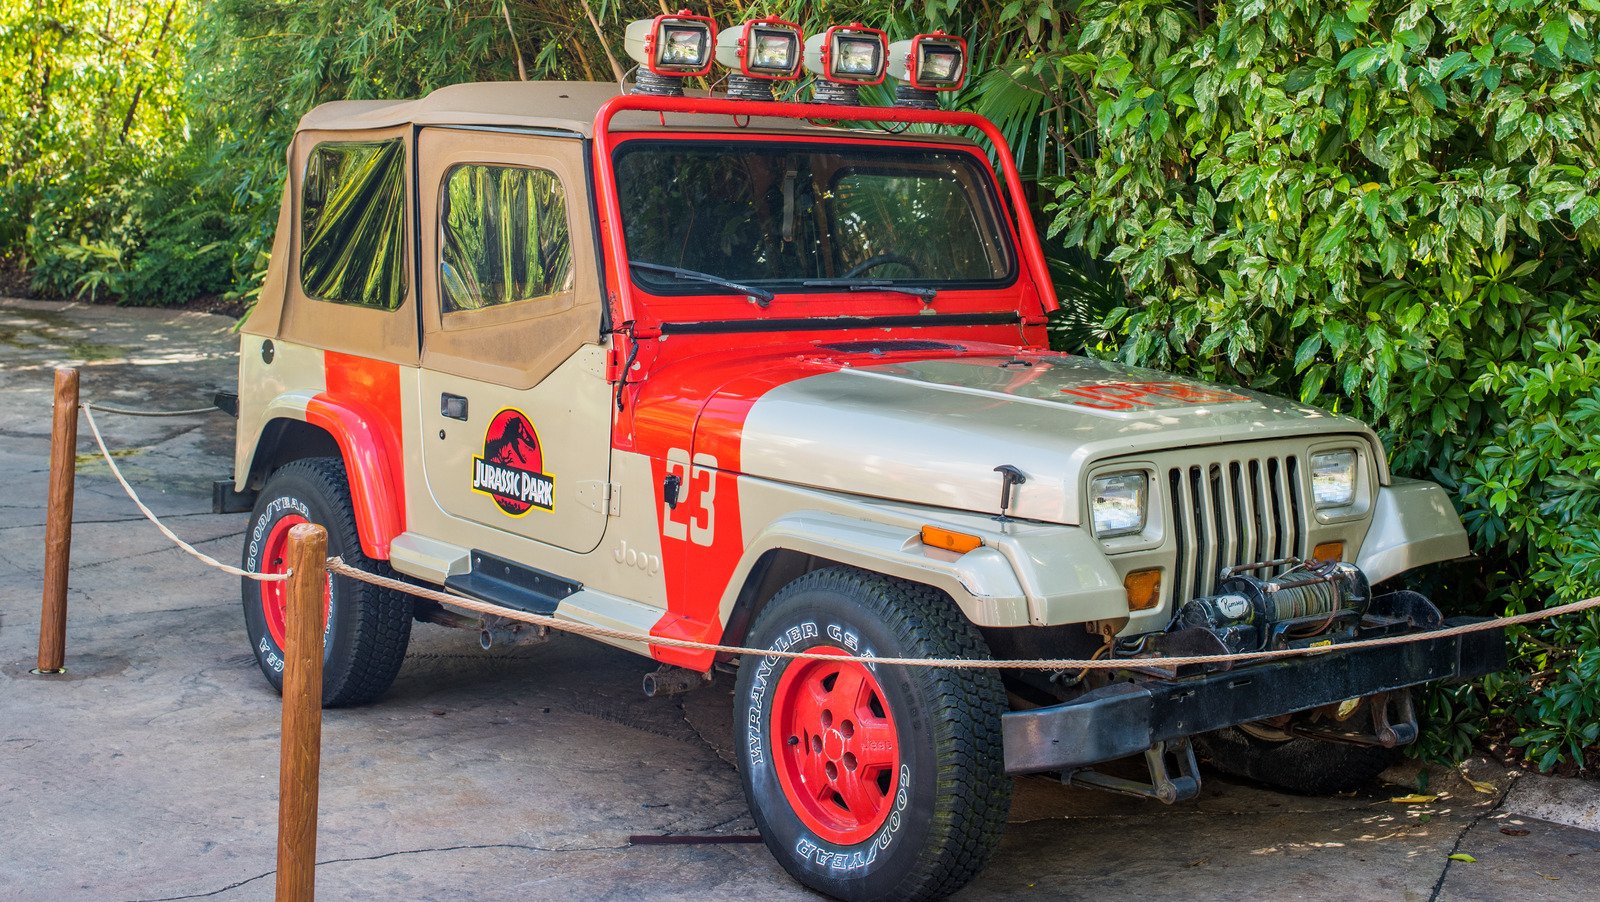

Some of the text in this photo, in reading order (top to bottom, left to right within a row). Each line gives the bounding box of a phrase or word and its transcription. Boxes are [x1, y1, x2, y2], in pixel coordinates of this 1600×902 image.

[473, 459, 553, 506] JURASSIC PARK
[663, 447, 718, 547] 23
[749, 622, 818, 764] WRANGLER
[796, 764, 910, 870] GOODYEAR
